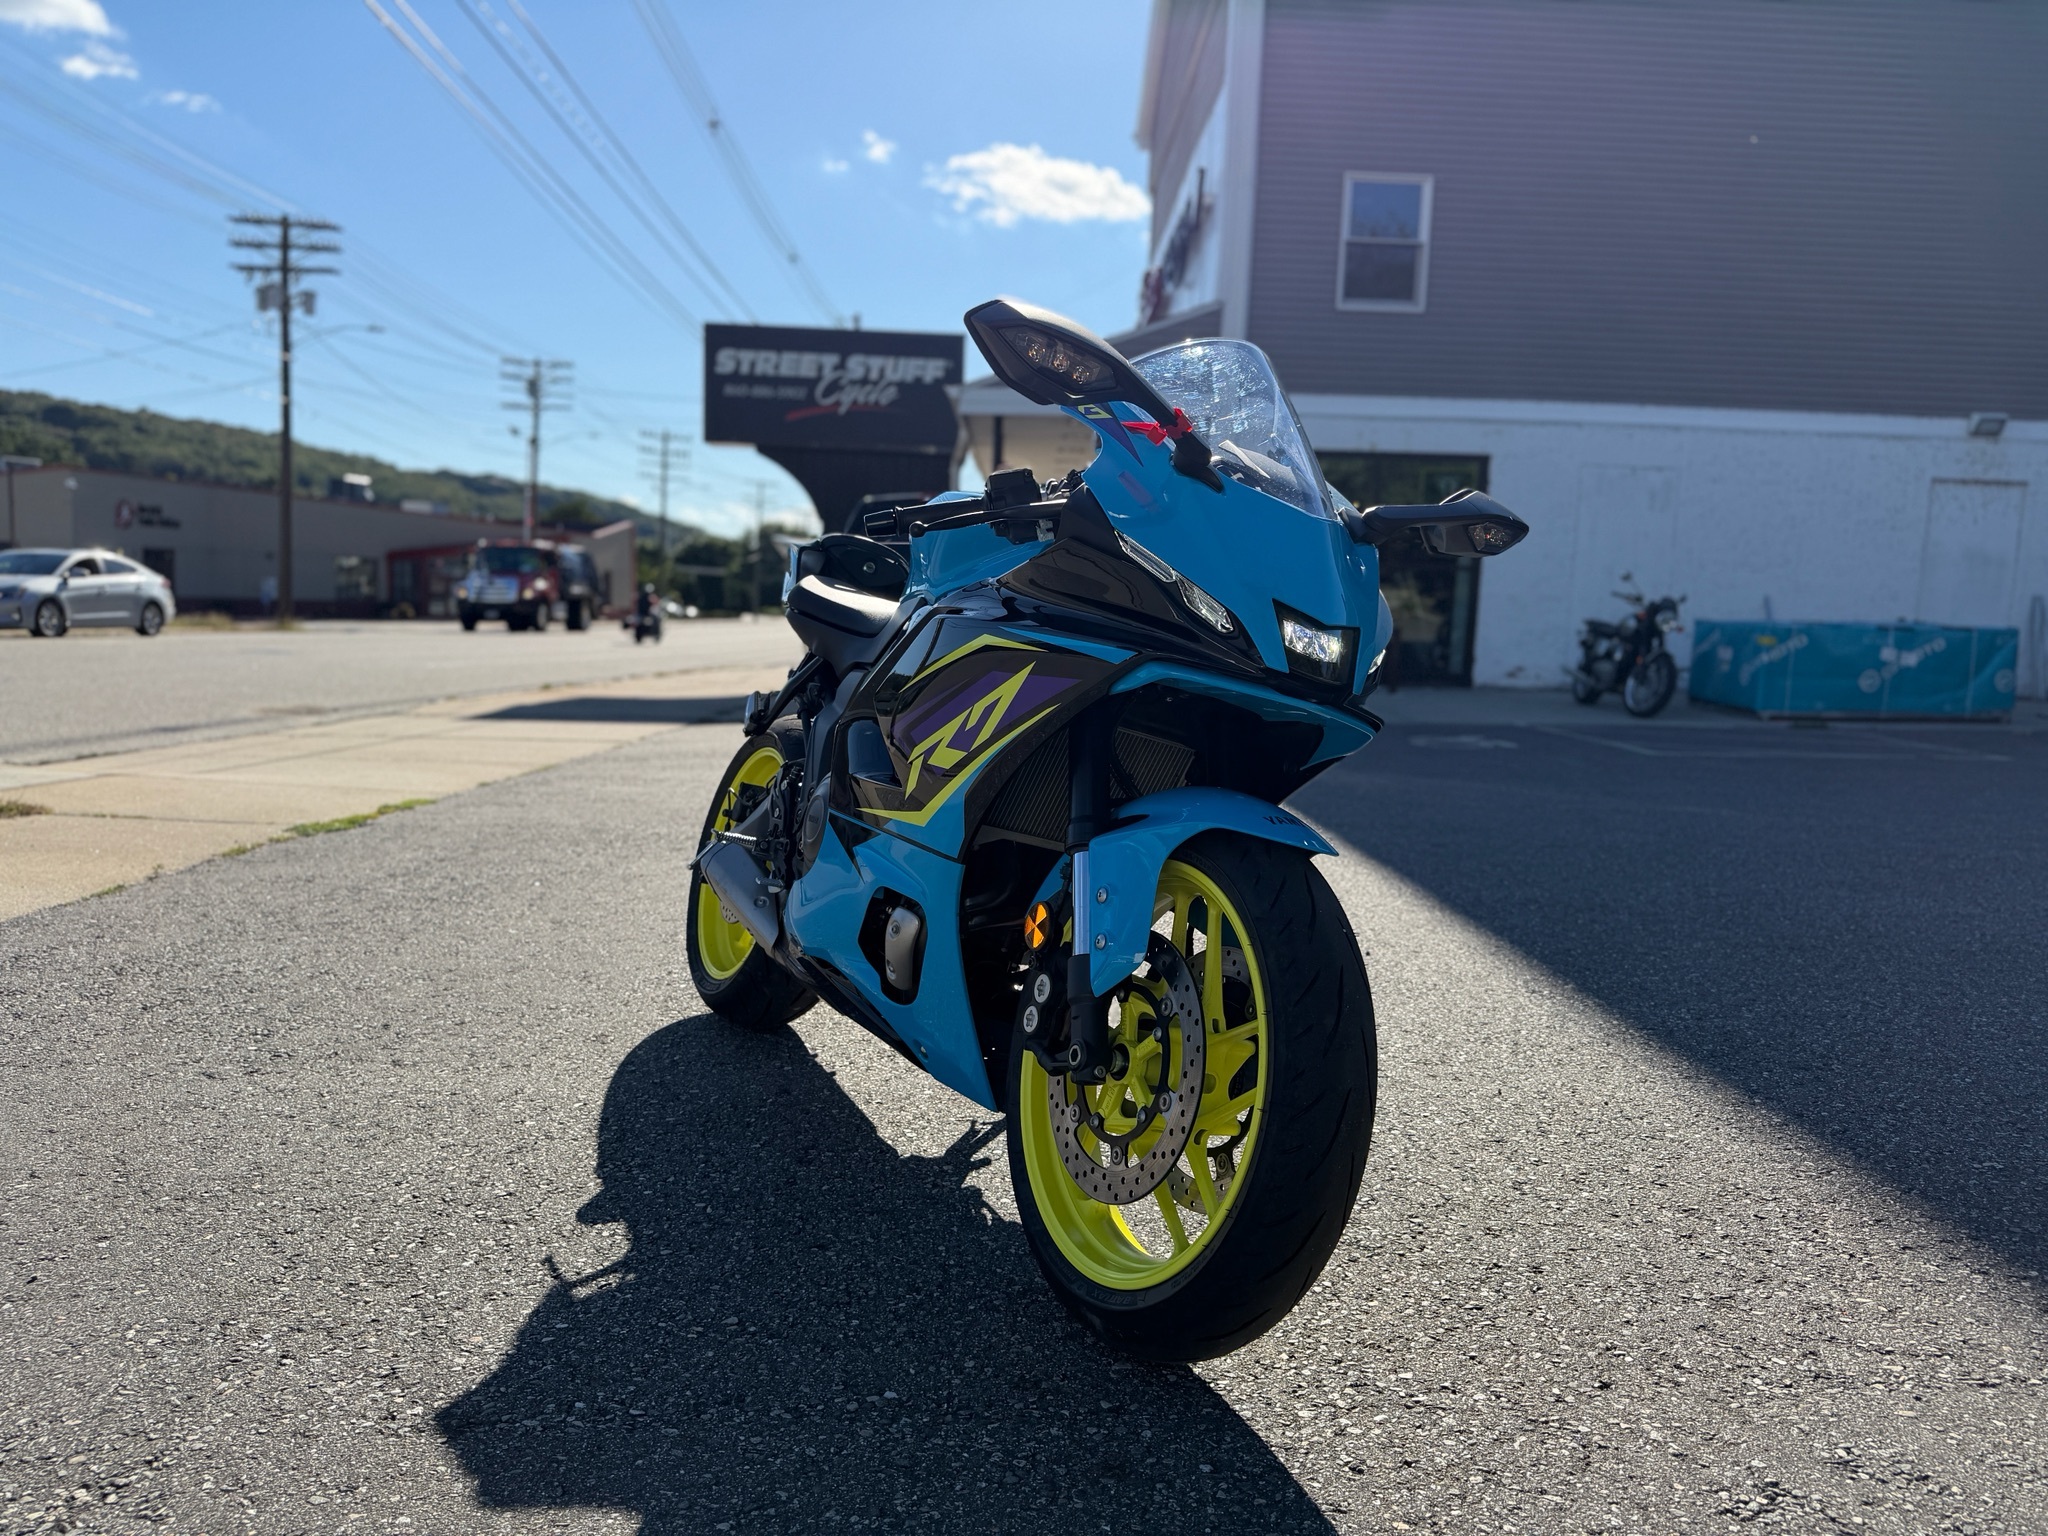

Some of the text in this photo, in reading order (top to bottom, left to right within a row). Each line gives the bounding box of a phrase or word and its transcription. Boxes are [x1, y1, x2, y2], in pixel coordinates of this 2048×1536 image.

[714, 347, 949, 384] STREET STUFF
[814, 370, 898, 415] Cycle
